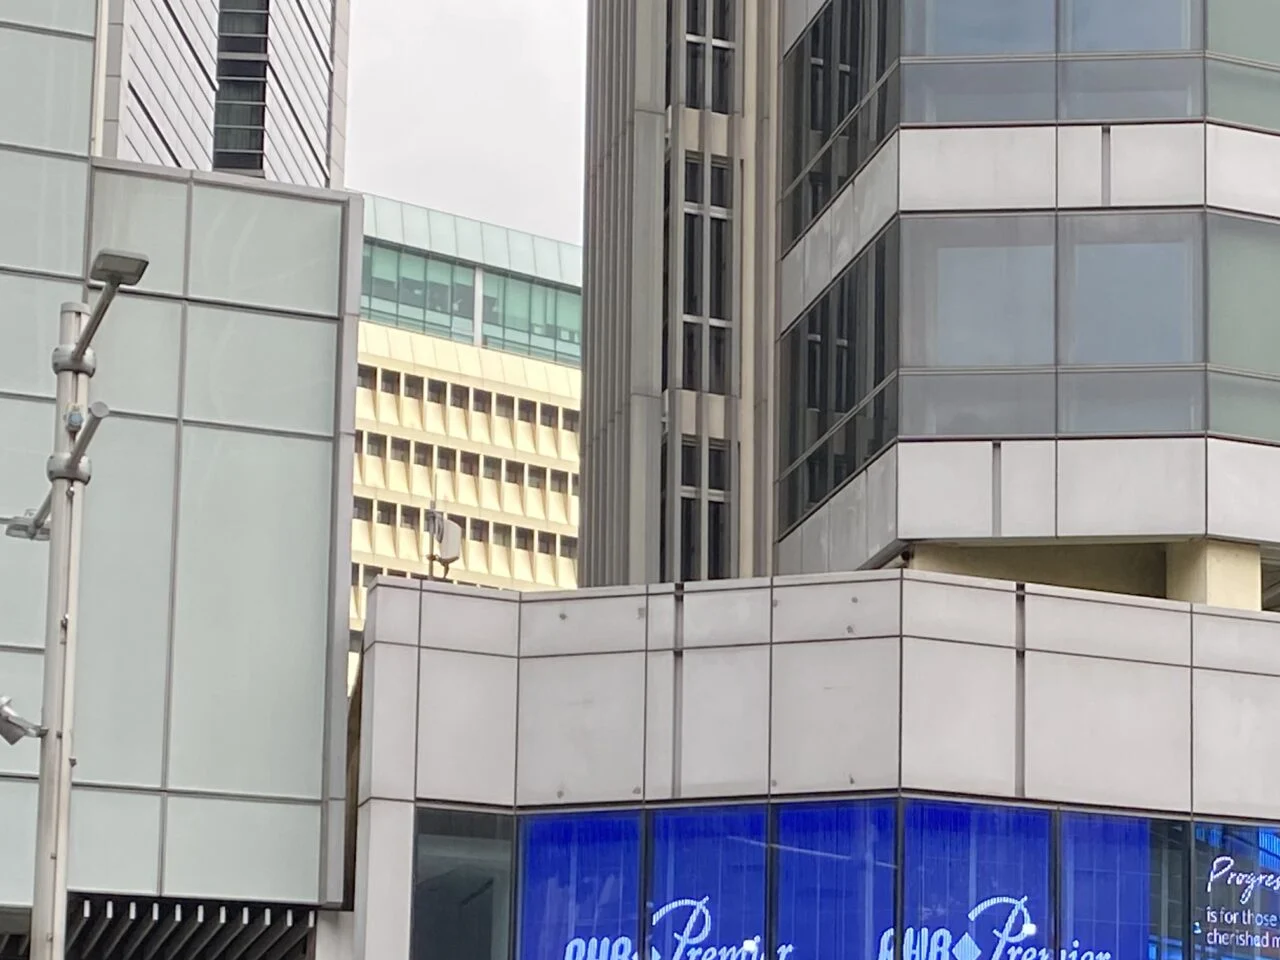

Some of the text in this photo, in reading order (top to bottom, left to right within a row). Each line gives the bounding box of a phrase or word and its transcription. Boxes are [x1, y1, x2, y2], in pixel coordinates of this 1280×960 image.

[1206, 906, 1218, 923] is
[1220, 907, 1240, 924] for
[1242, 909, 1278, 927] those
[1206, 928, 1270, 948] cherished
